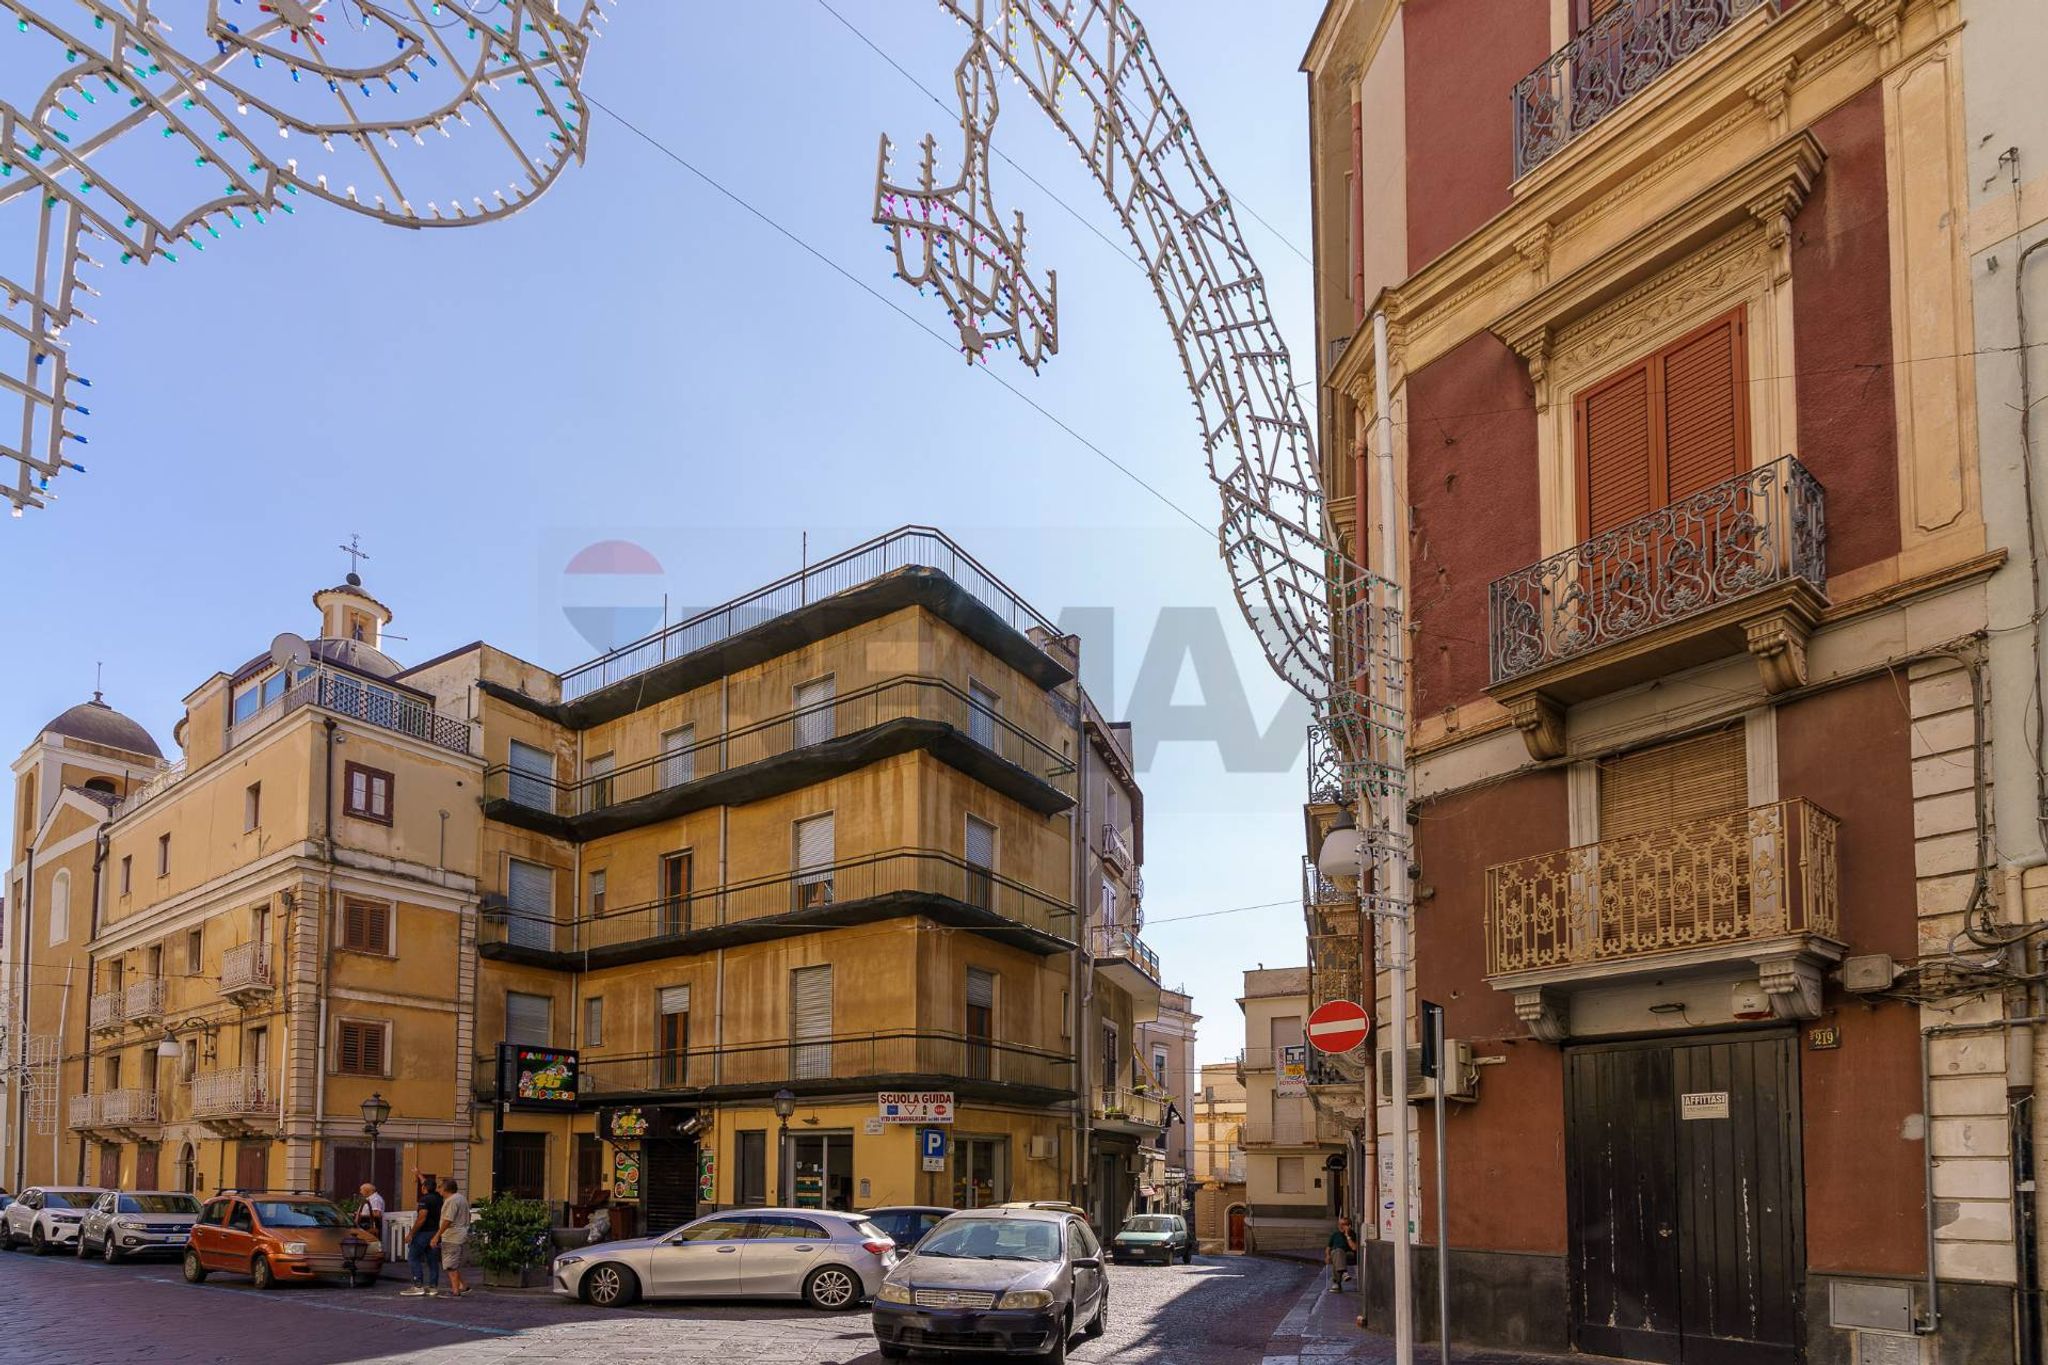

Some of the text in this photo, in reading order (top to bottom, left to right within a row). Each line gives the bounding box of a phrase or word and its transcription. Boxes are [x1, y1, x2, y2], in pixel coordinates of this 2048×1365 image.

[1815, 1031, 1833, 1045] 219
[880, 1093, 952, 1104] SCUOLA GUIDA
[1685, 1095, 1725, 1106] AFFITTASI
[927, 1133, 941, 1154] P
